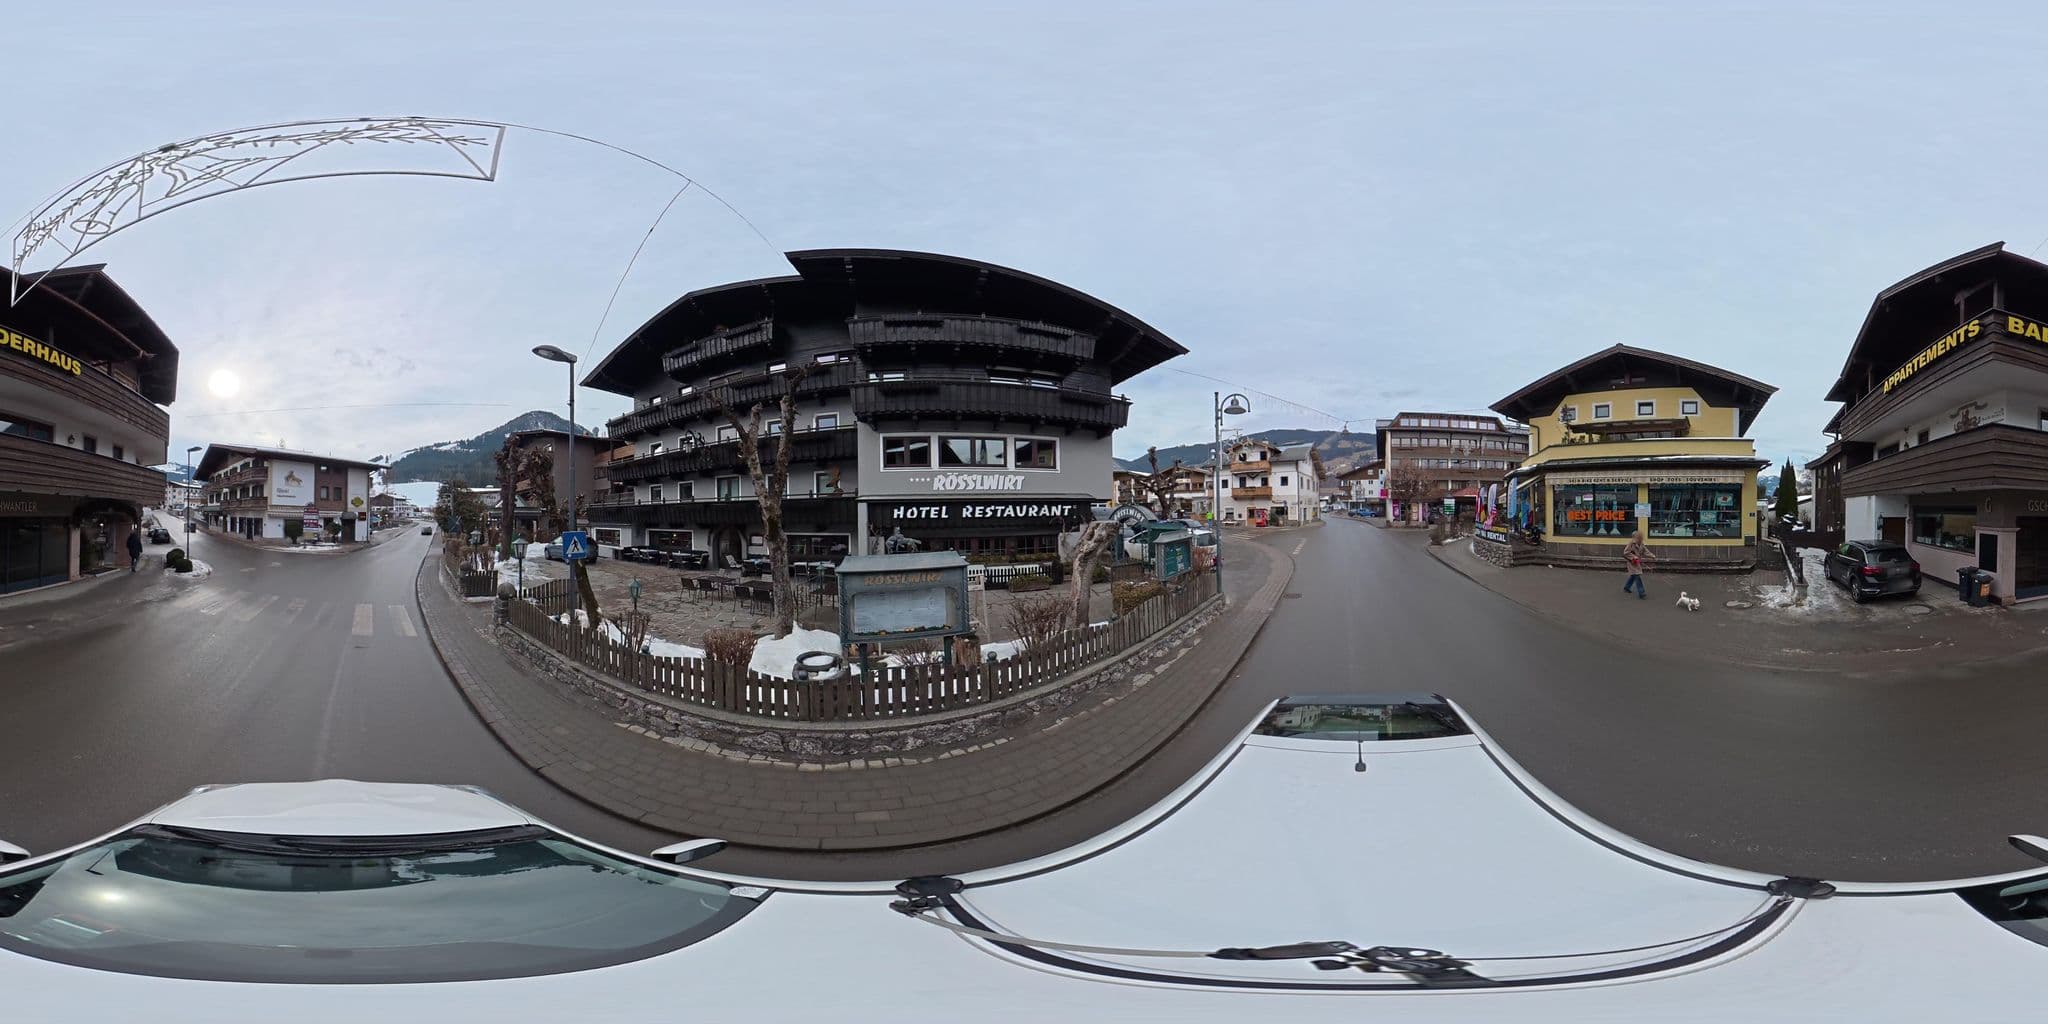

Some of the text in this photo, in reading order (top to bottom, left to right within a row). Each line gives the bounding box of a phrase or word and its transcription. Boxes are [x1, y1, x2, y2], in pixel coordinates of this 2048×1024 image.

[0, 328, 81, 375] DERHAUS
[1883, 319, 1981, 394] APPARTEMENTS
[933, 472, 1024, 491] RÖSSLWIRT
[893, 505, 1072, 519] HOTEL RESTAURANT
[1567, 510, 1592, 521] BEST
[1595, 510, 1625, 521] PRICE
